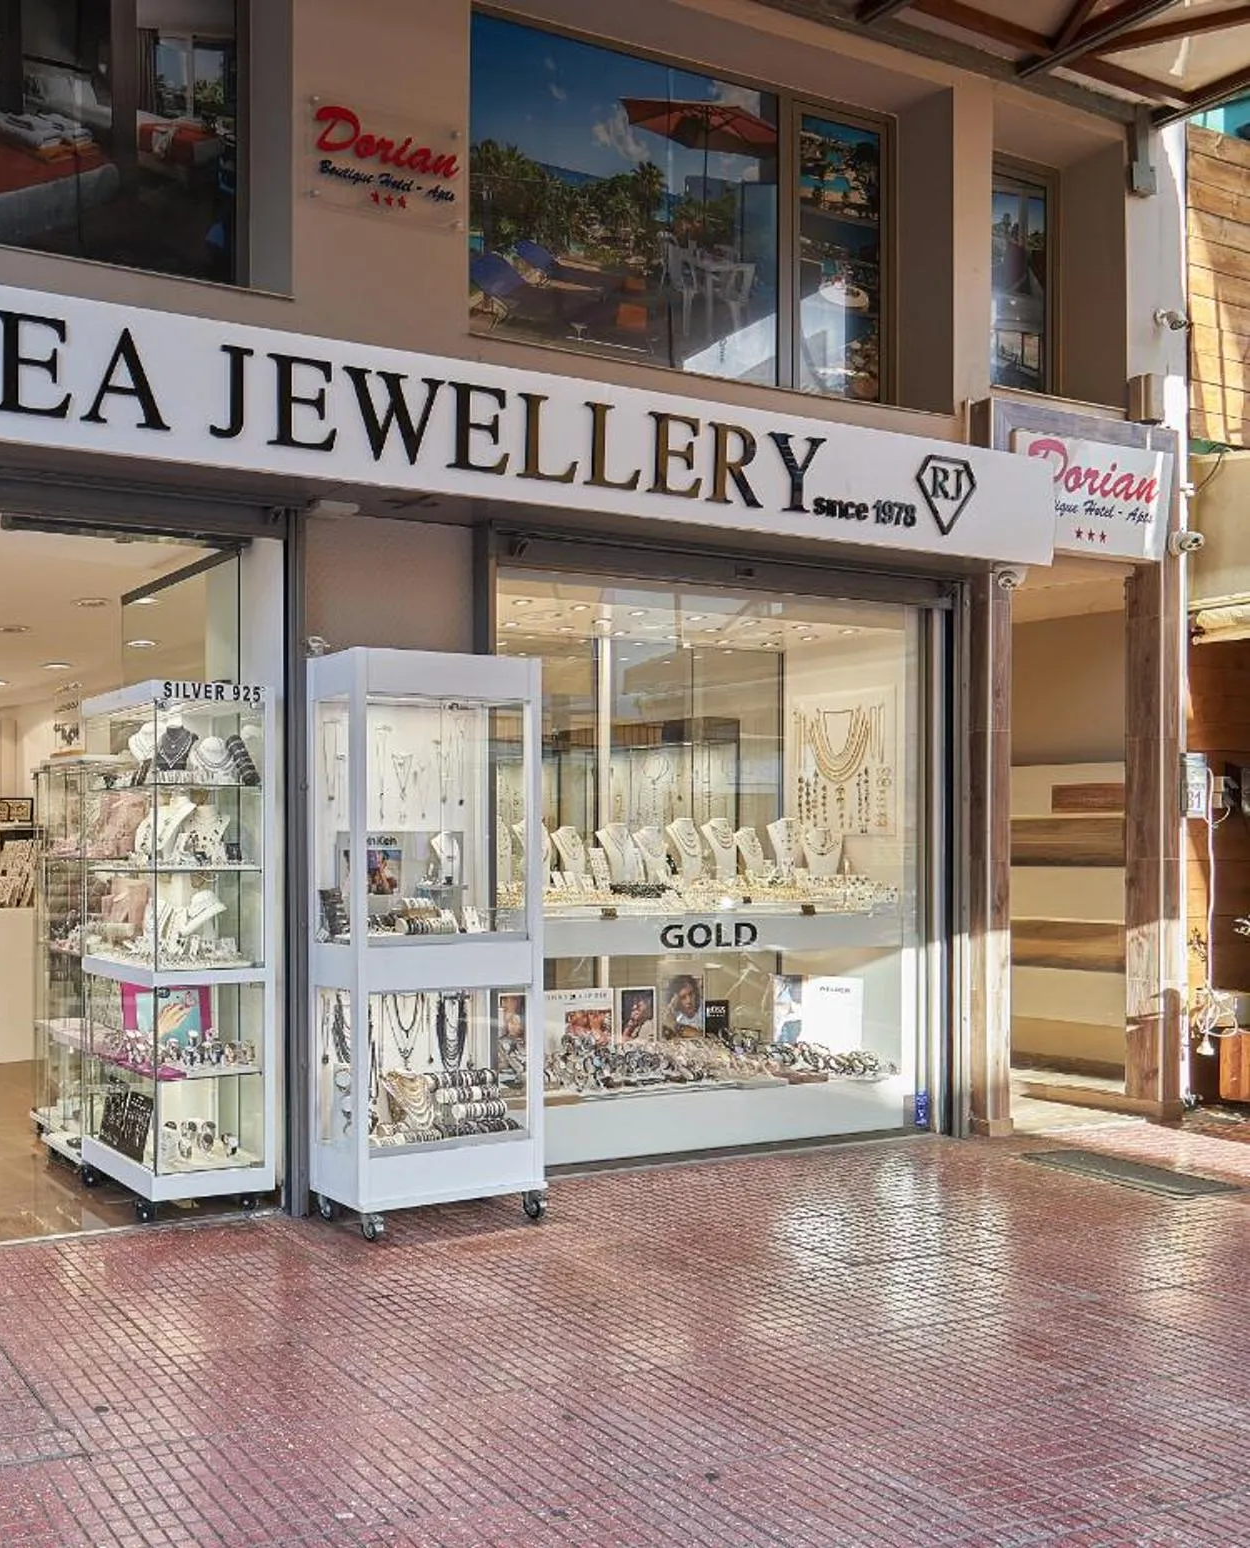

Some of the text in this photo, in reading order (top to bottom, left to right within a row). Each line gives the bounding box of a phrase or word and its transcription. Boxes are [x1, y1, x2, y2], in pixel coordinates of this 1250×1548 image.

[315, 106, 459, 179] Dorian
[319, 159, 373, 185] Boutique
[377, 172, 414, 192] Hotel
[209, 344, 827, 514] JEWELLERY
[931, 466, 964, 501] RJ
[813, 496, 917, 527] since 1978
[1083, 500, 1115, 519] Hotel
[164, 681, 224, 700] SILVER
[660, 923, 758, 948] GOLD
